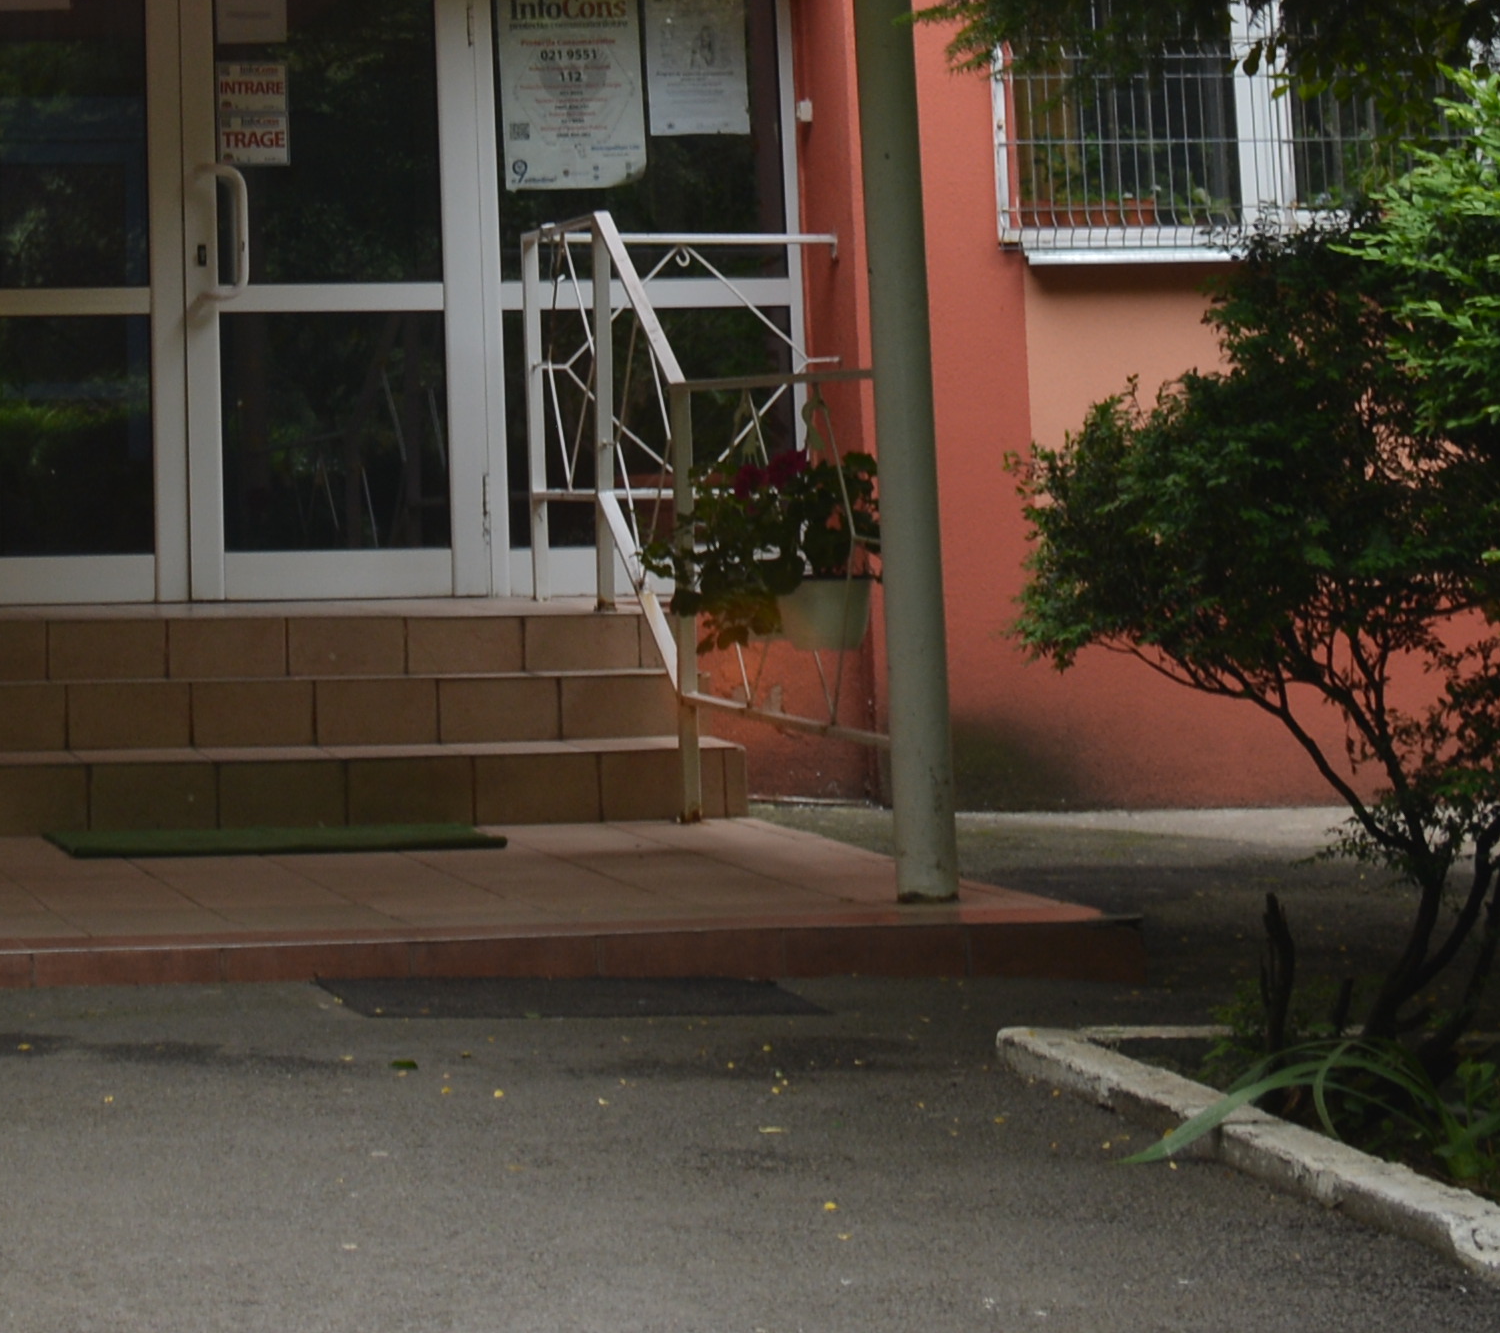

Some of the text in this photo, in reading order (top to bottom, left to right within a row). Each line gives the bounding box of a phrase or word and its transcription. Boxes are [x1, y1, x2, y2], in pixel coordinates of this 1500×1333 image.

[540, 48, 598, 61] 021 9551
[559, 70, 582, 83] 112
[219, 80, 285, 95] INTRARE
[222, 131, 286, 149] TRAGE
